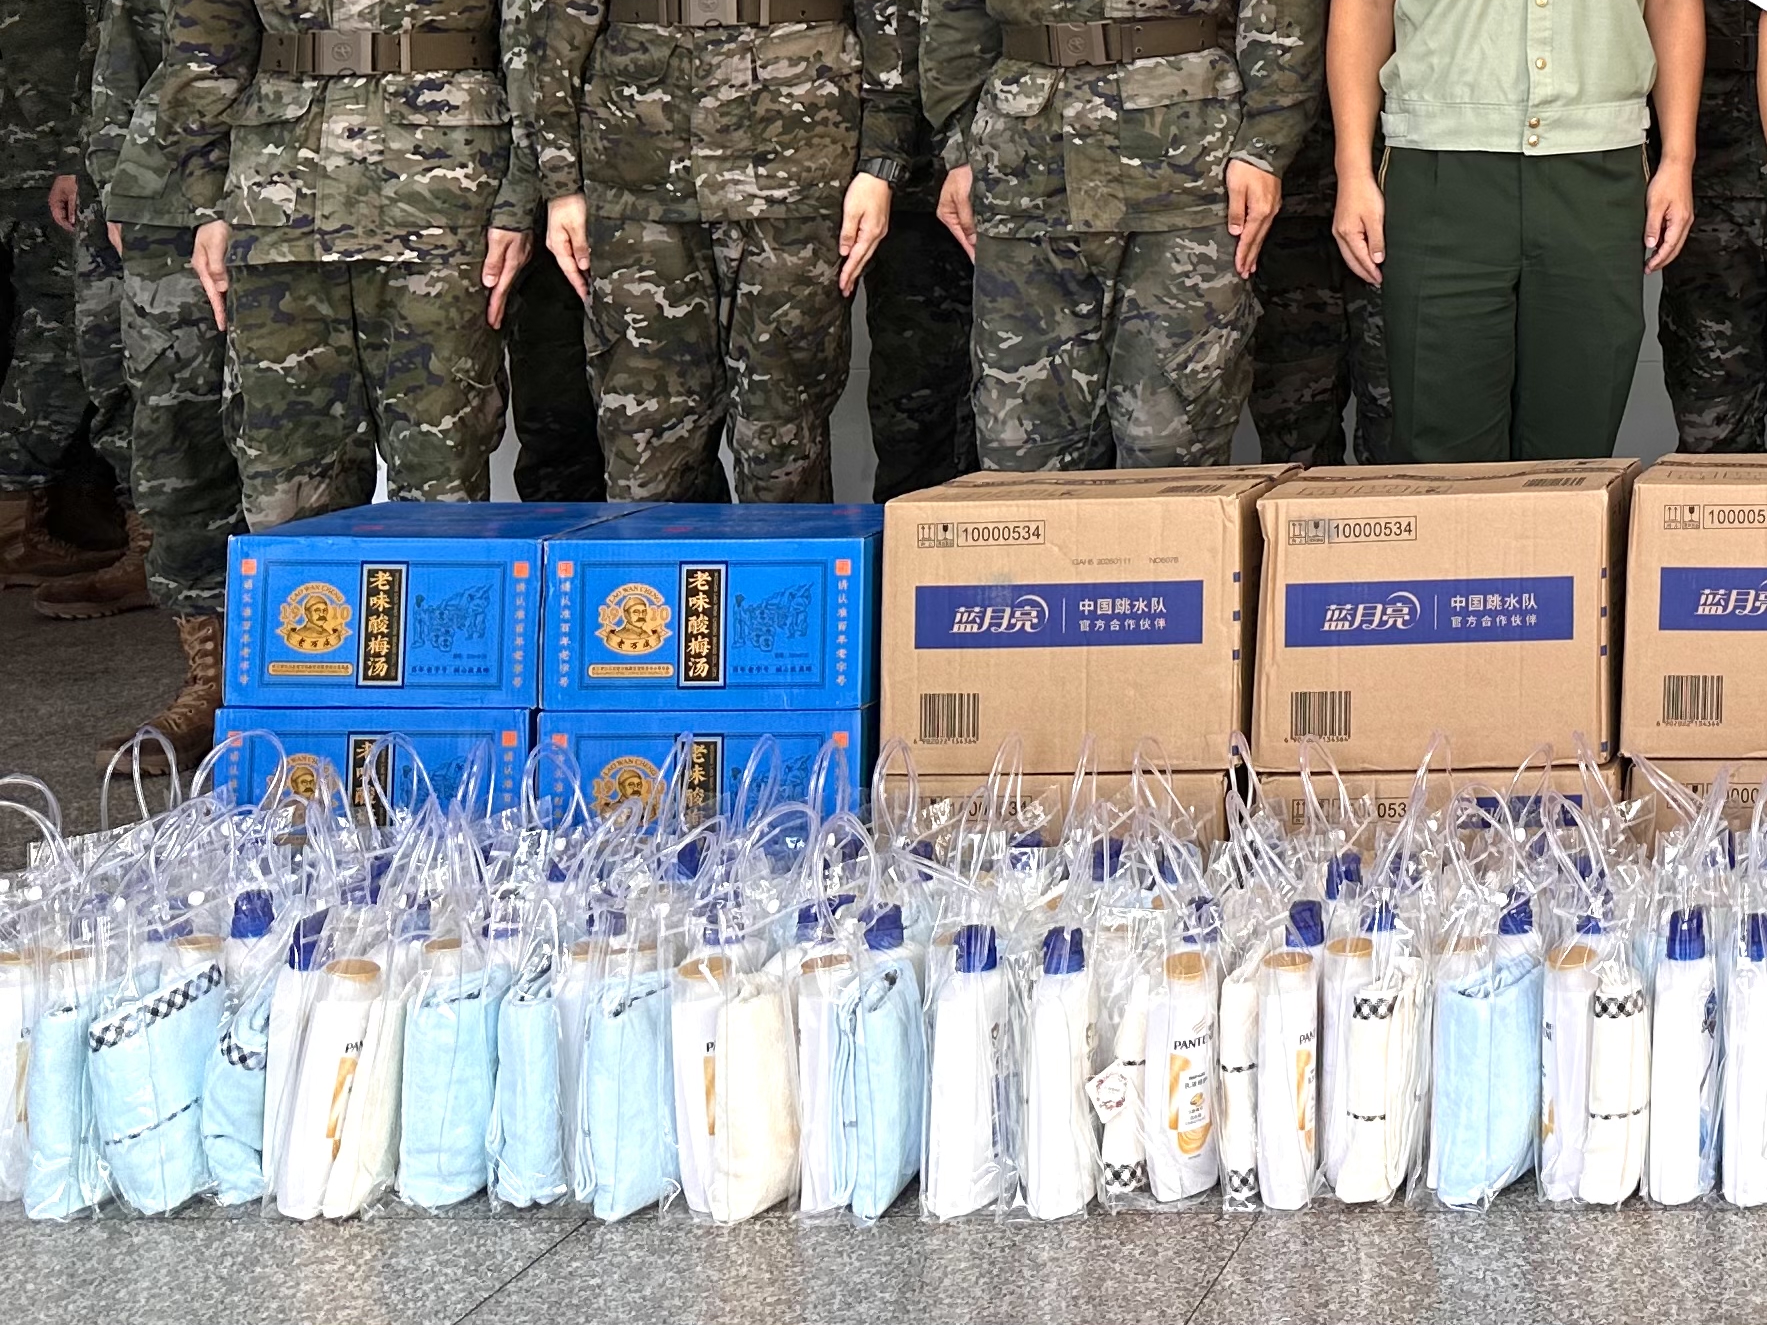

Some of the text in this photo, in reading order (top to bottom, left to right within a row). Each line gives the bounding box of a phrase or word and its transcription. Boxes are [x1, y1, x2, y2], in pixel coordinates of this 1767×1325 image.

[962, 525, 1041, 542] 10000534
[1334, 521, 1412, 539] 10000534
[1079, 597, 1167, 615] 中国跳水队
[1322, 592, 1421, 630] 蓝月亮
[1450, 593, 1537, 612] 中国跳水队
[951, 595, 1049, 632] 蓝月亮
[1451, 614, 1537, 628] 官方合作伙伴
[367, 570, 393, 677] 老味酸梅汤
[686, 571, 712, 678] 老味酸梅汤
[1079, 617, 1166, 632] 官方合作伙伴
